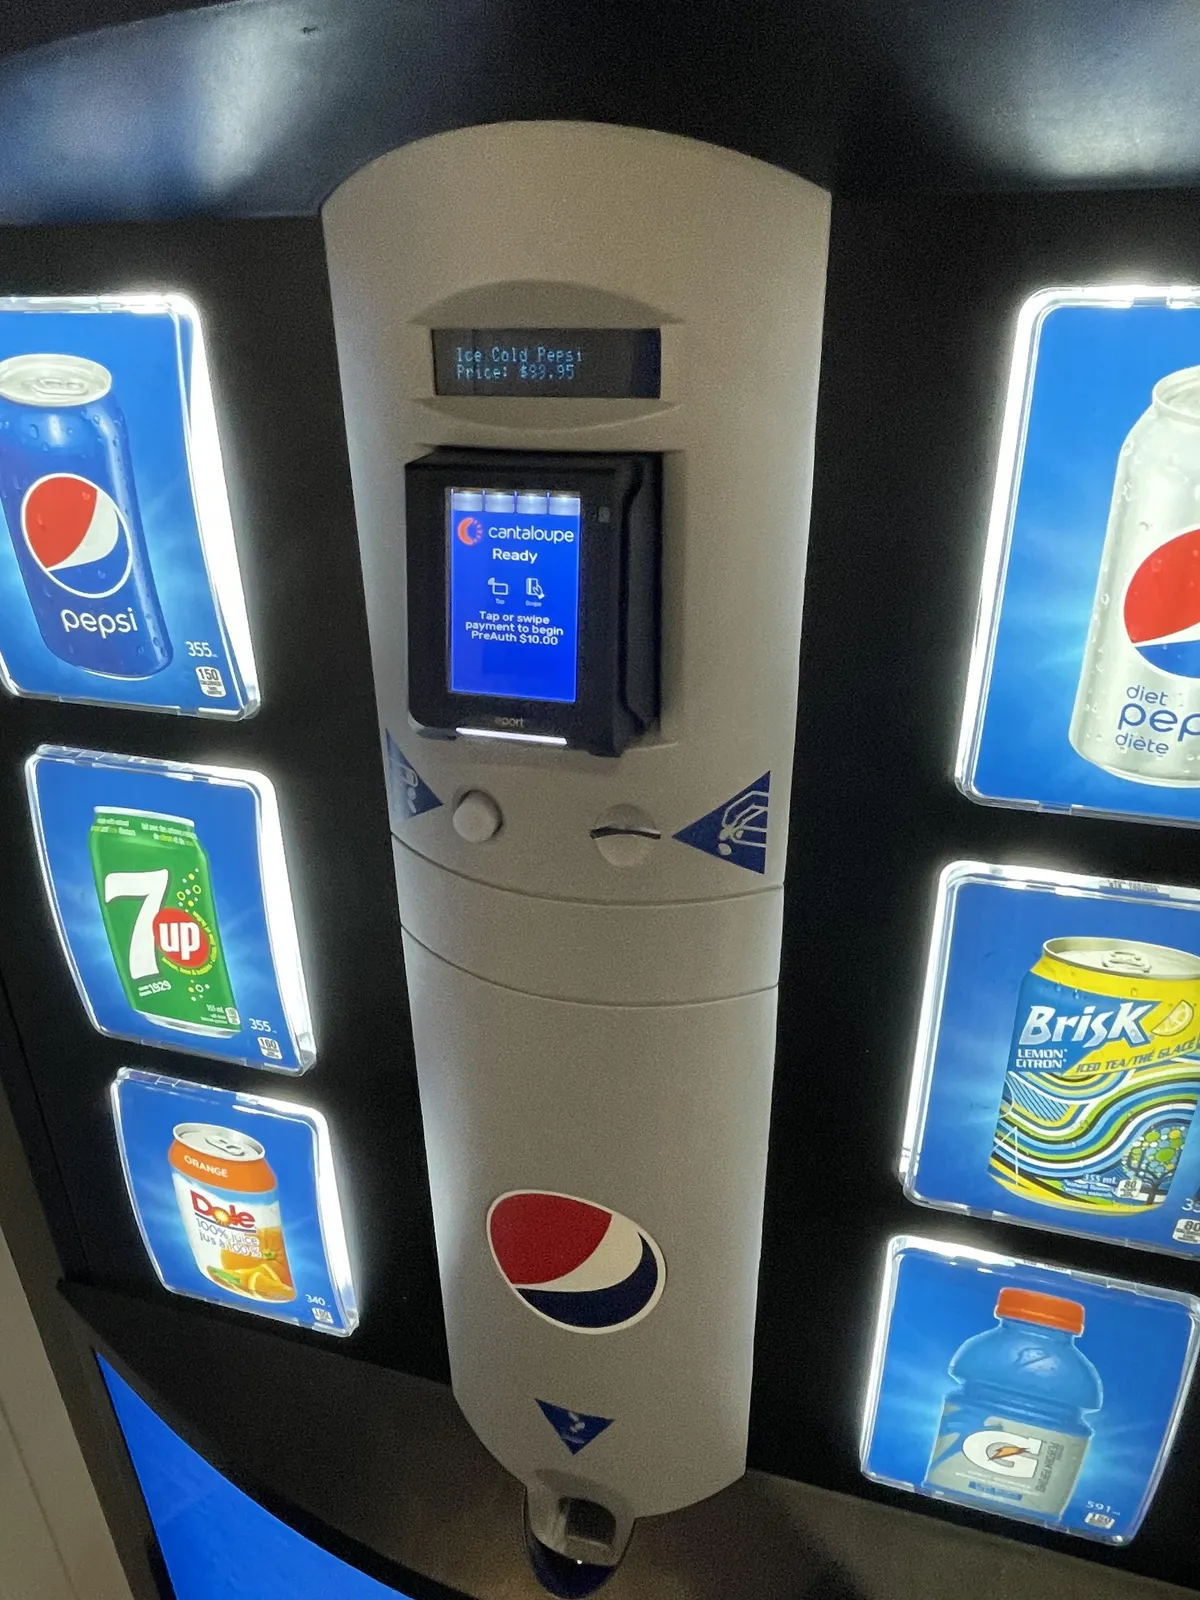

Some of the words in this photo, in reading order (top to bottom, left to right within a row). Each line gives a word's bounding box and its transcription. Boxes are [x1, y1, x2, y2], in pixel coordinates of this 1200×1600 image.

[456, 346, 482, 362] Ice
[492, 346, 528, 362] Cold
[537, 346, 582, 363] Pepsi
[456, 364, 508, 379] Price:
[488, 525, 575, 544] cantaloupe
[492, 547, 538, 564] Ready
[60, 607, 139, 639] pepsi
[479, 610, 500, 622] Tap
[502, 614, 515, 622] or
[517, 614, 550, 626] swipe
[465, 621, 515, 633] payment
[517, 623, 529, 633] to
[532, 624, 564, 637] begin
[471, 630, 517, 643] PreAuth
[519, 633, 558, 646] $10.00
[185, 640, 212, 658] 355
[198, 668, 220, 681] 150
[1126, 685, 1169, 706] diet
[1117, 703, 1200, 742] pep
[1115, 732, 1169, 755] diète
[148, 980, 172, 994] 1929
[248, 1018, 271, 1033] 355
[183, 1153, 229, 1178] ORANGE
[190, 1189, 256, 1228] Dole
[196, 1217, 229, 1240] 100%
[305, 1294, 326, 1306] 340
[962, 1430, 1042, 1478] G
